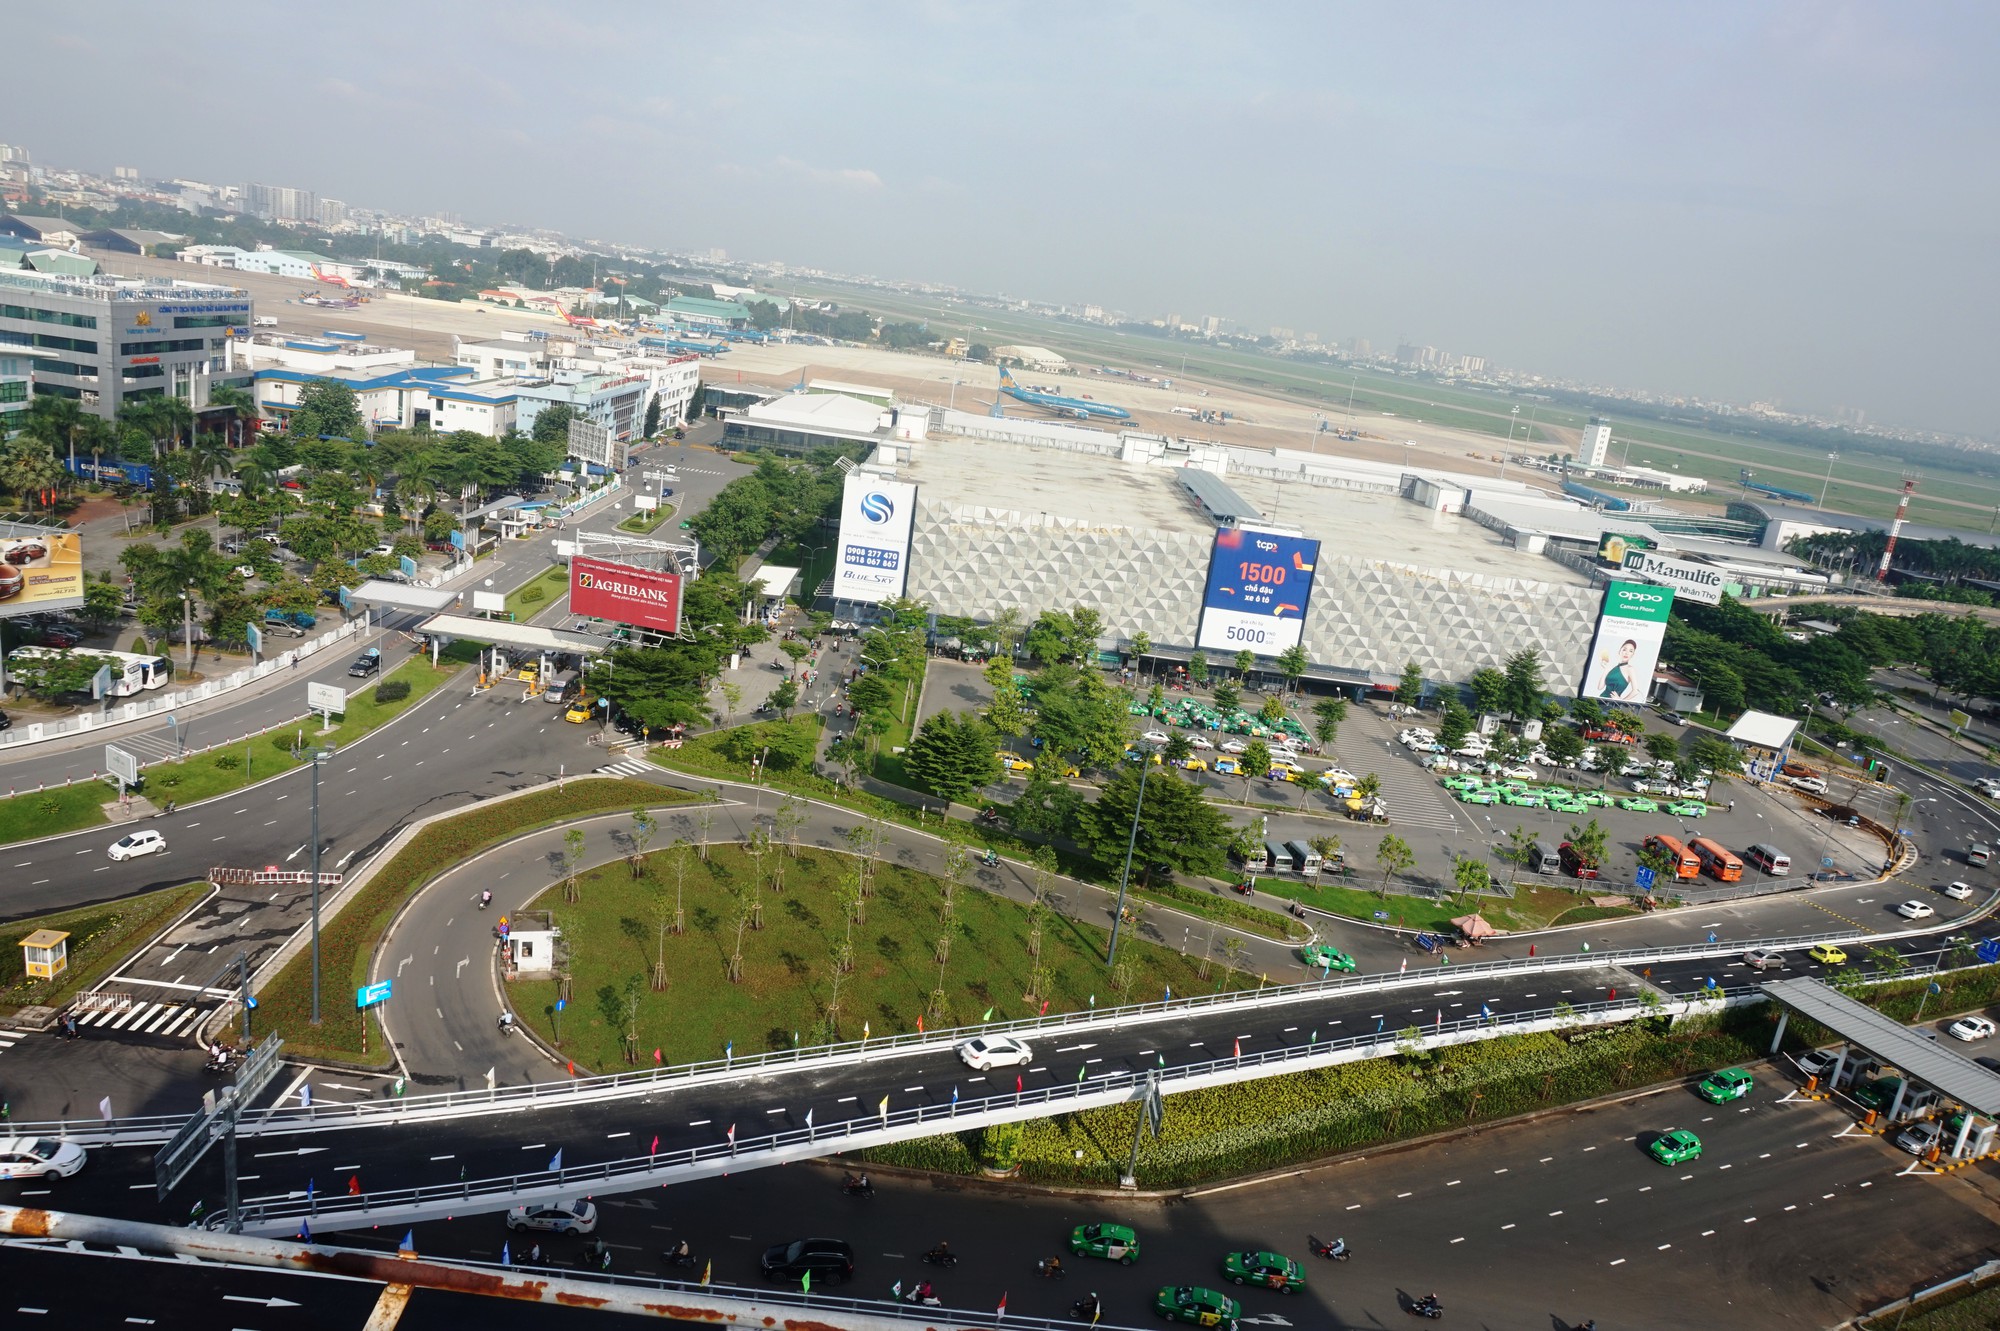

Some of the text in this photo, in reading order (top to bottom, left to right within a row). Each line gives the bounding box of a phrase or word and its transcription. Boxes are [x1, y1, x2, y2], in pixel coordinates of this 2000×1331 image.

[847, 546, 898, 560] 0908 277 470
[846, 554, 897, 568] 0918 067 867
[1240, 562, 1286, 585] 1500
[1645, 558, 1721, 587] Manulife
[594, 579, 669, 602] AGRIBANK
[1259, 586, 1274, 595] đậu
[1679, 586, 1700, 597] Nhân
[1702, 590, 1717, 600] Thọ
[1244, 594, 1254, 602] xe
[1261, 595, 1270, 604] tô
[1619, 603, 1656, 613] Camera Phone
[1226, 626, 1265, 643] 5000
